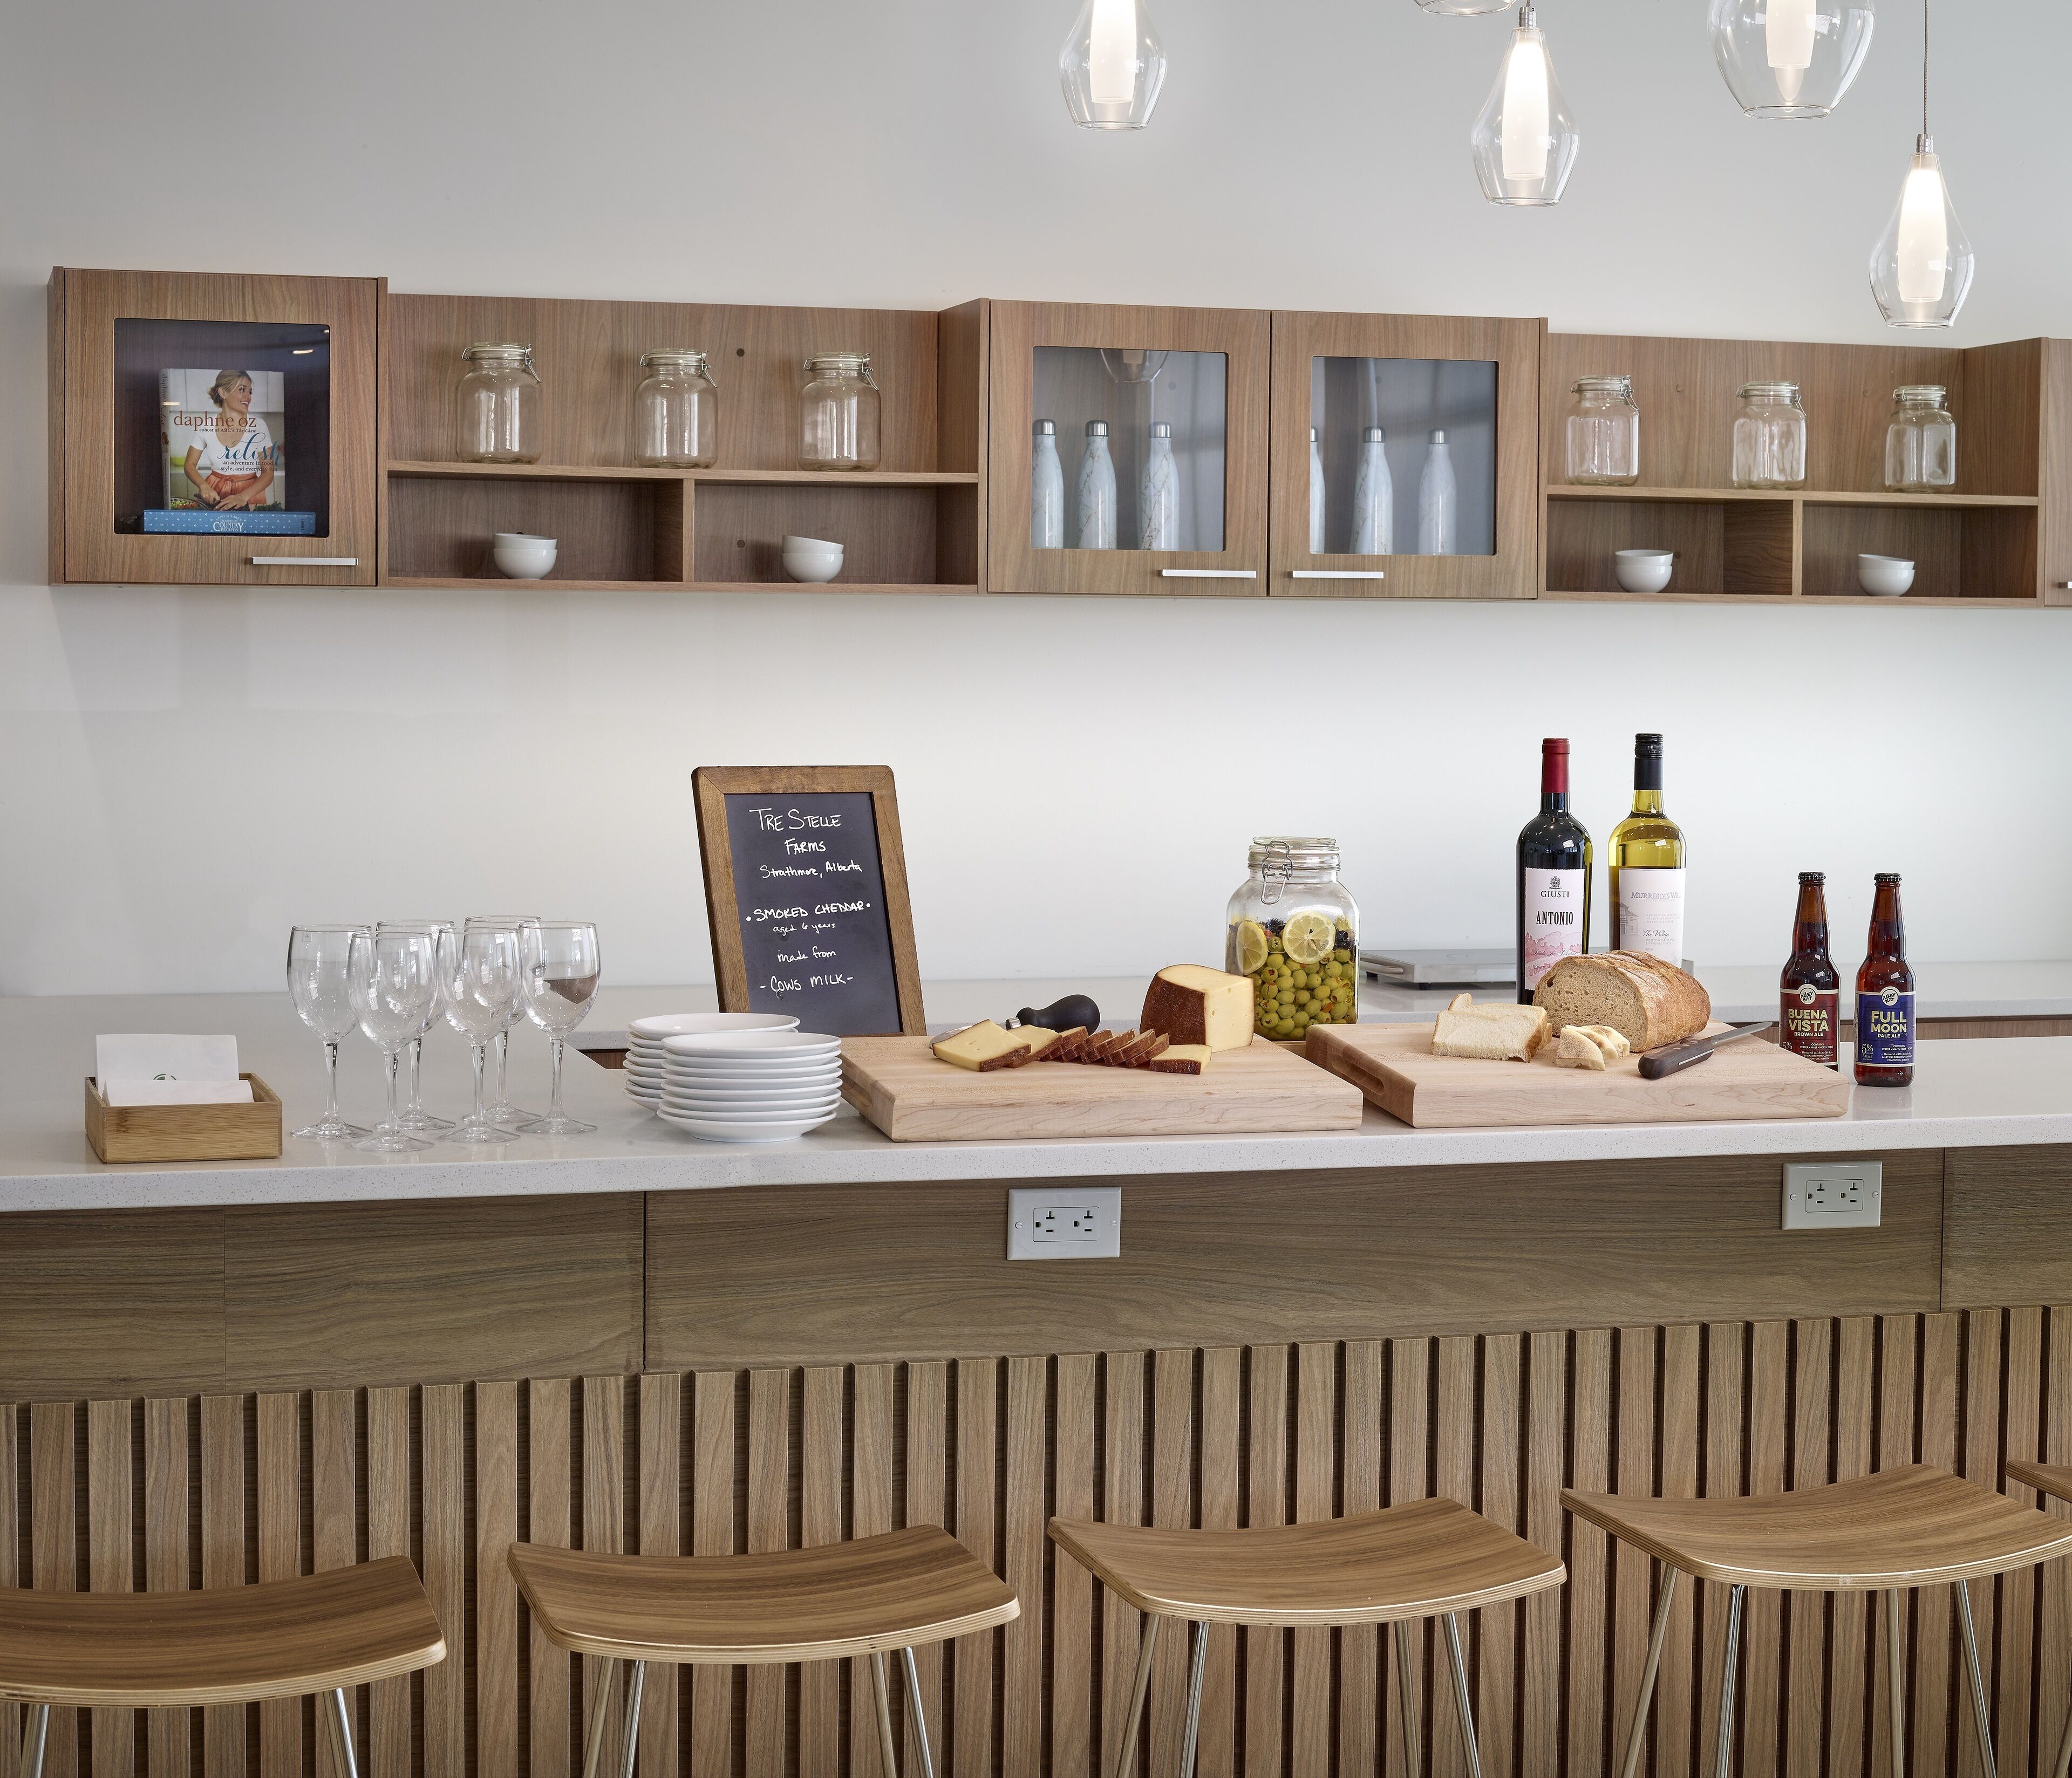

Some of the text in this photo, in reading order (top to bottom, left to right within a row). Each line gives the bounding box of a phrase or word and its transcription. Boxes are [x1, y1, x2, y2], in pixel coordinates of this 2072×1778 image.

[174, 411, 234, 431] daphne
[238, 418, 257, 427] oz
[217, 432, 281, 467] relish
[213, 522, 244, 532] COUNTRY
[748, 808, 841, 831] TRE STELLE
[824, 859, 863, 873] Alberta
[1536, 911, 1573, 925] ANTONIO
[773, 924, 797, 936] aged
[811, 922, 835, 934] years
[1653, 929, 1669, 941] Whip
[777, 946, 836, 962] made from
[1801, 991, 1814, 999] ALLEY
[1788, 1009, 1828, 1019] BUENA
[1871, 1011, 1907, 1023] FULL
[1788, 1019, 1829, 1031] VISTA
[1871, 1023, 1907, 1033] MOON
[1783, 1041, 1792, 1050] 5%
[1862, 1043, 1873, 1054] 5%
